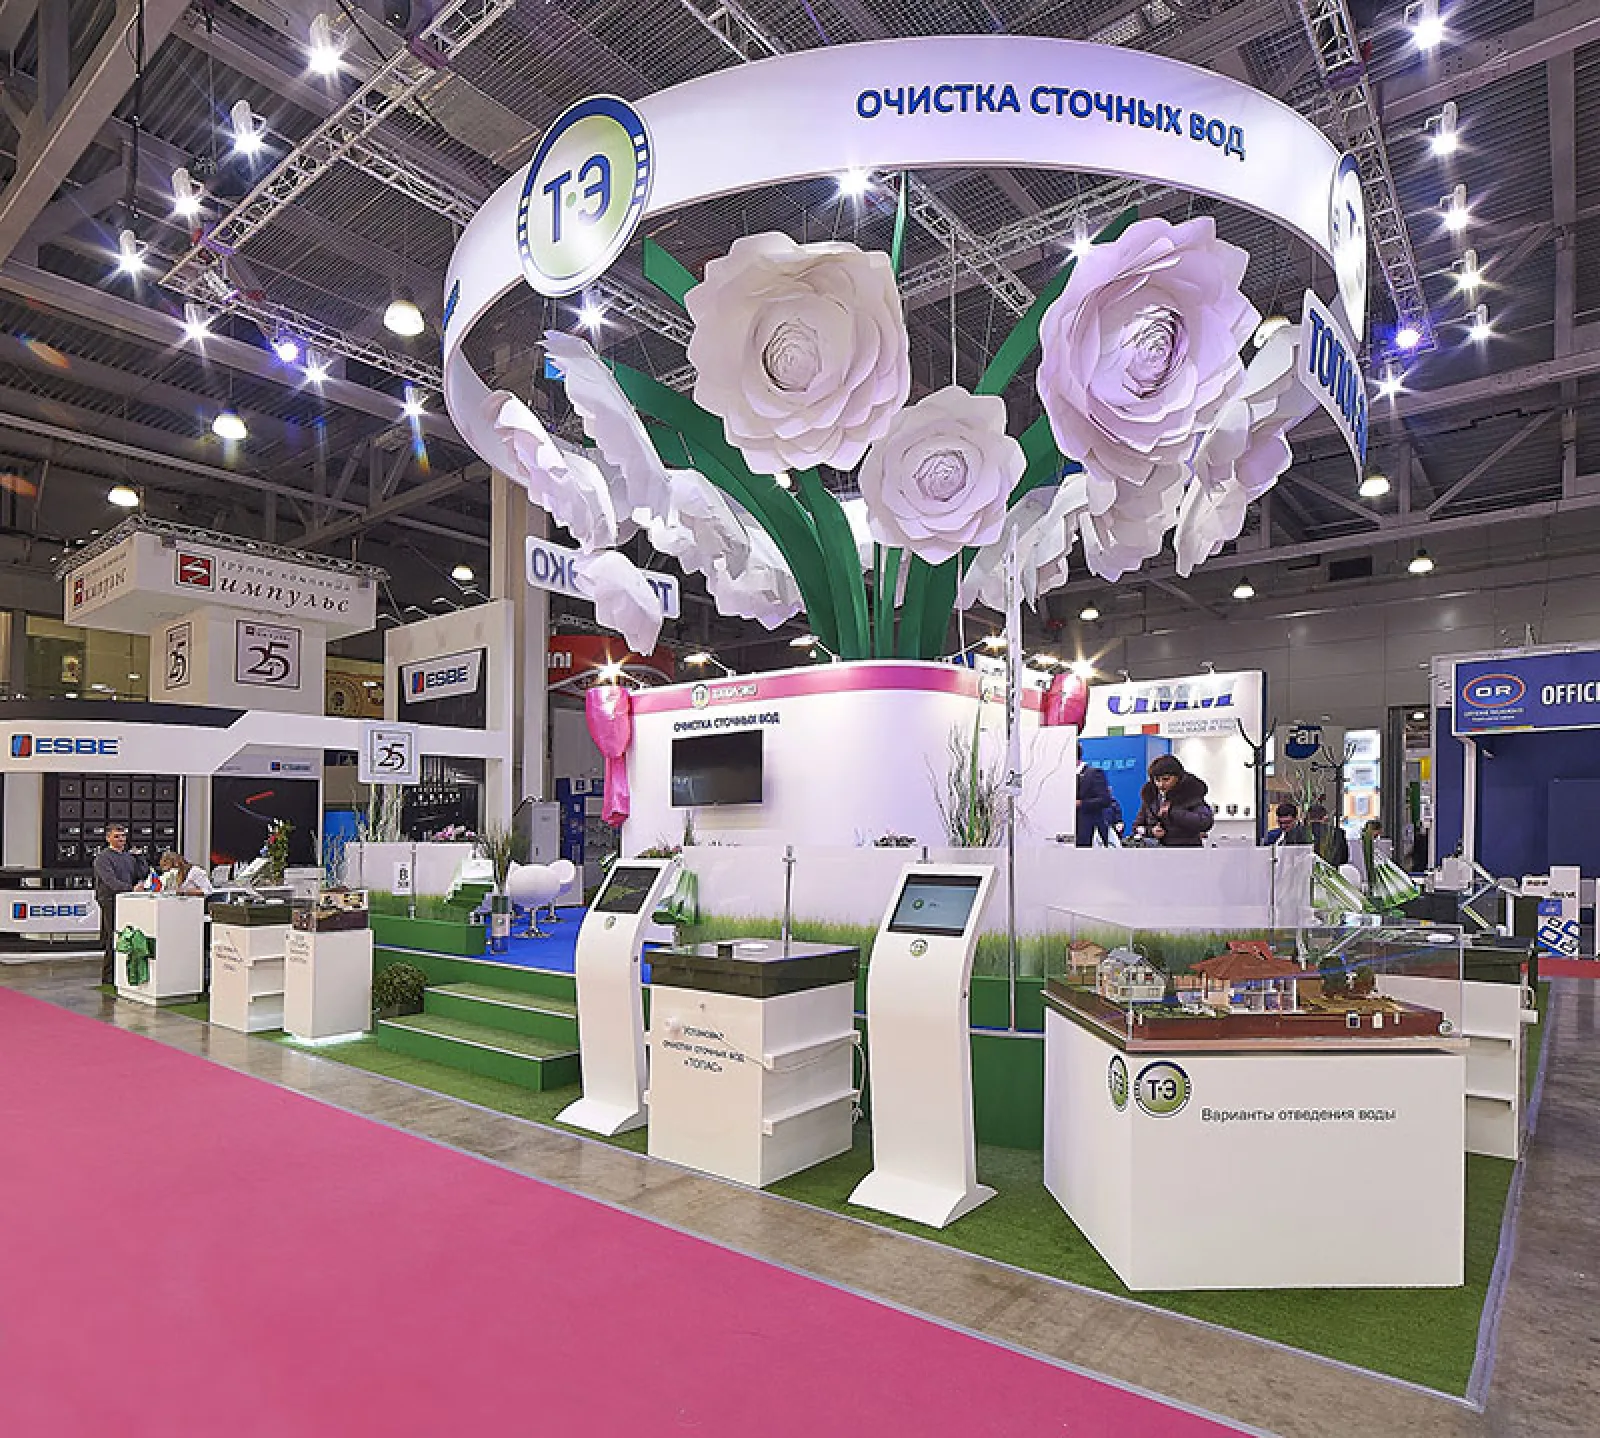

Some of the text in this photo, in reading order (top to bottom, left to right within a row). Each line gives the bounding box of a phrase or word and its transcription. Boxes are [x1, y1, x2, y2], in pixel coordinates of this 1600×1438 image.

[856, 83, 1247, 162] ОЧИСТКА СТОЧНЫХ ВОД
[220, 577, 349, 613] импульс
[248, 641, 290, 683] 25
[426, 665, 468, 689] ESBE
[1541, 681, 1600, 706] OFFIC
[35, 737, 119, 755] ESBE
[378, 743, 405, 770] 25
[29, 904, 87, 917] ESBE
[1200, 1107, 1397, 1122] Варианты отведения воды
